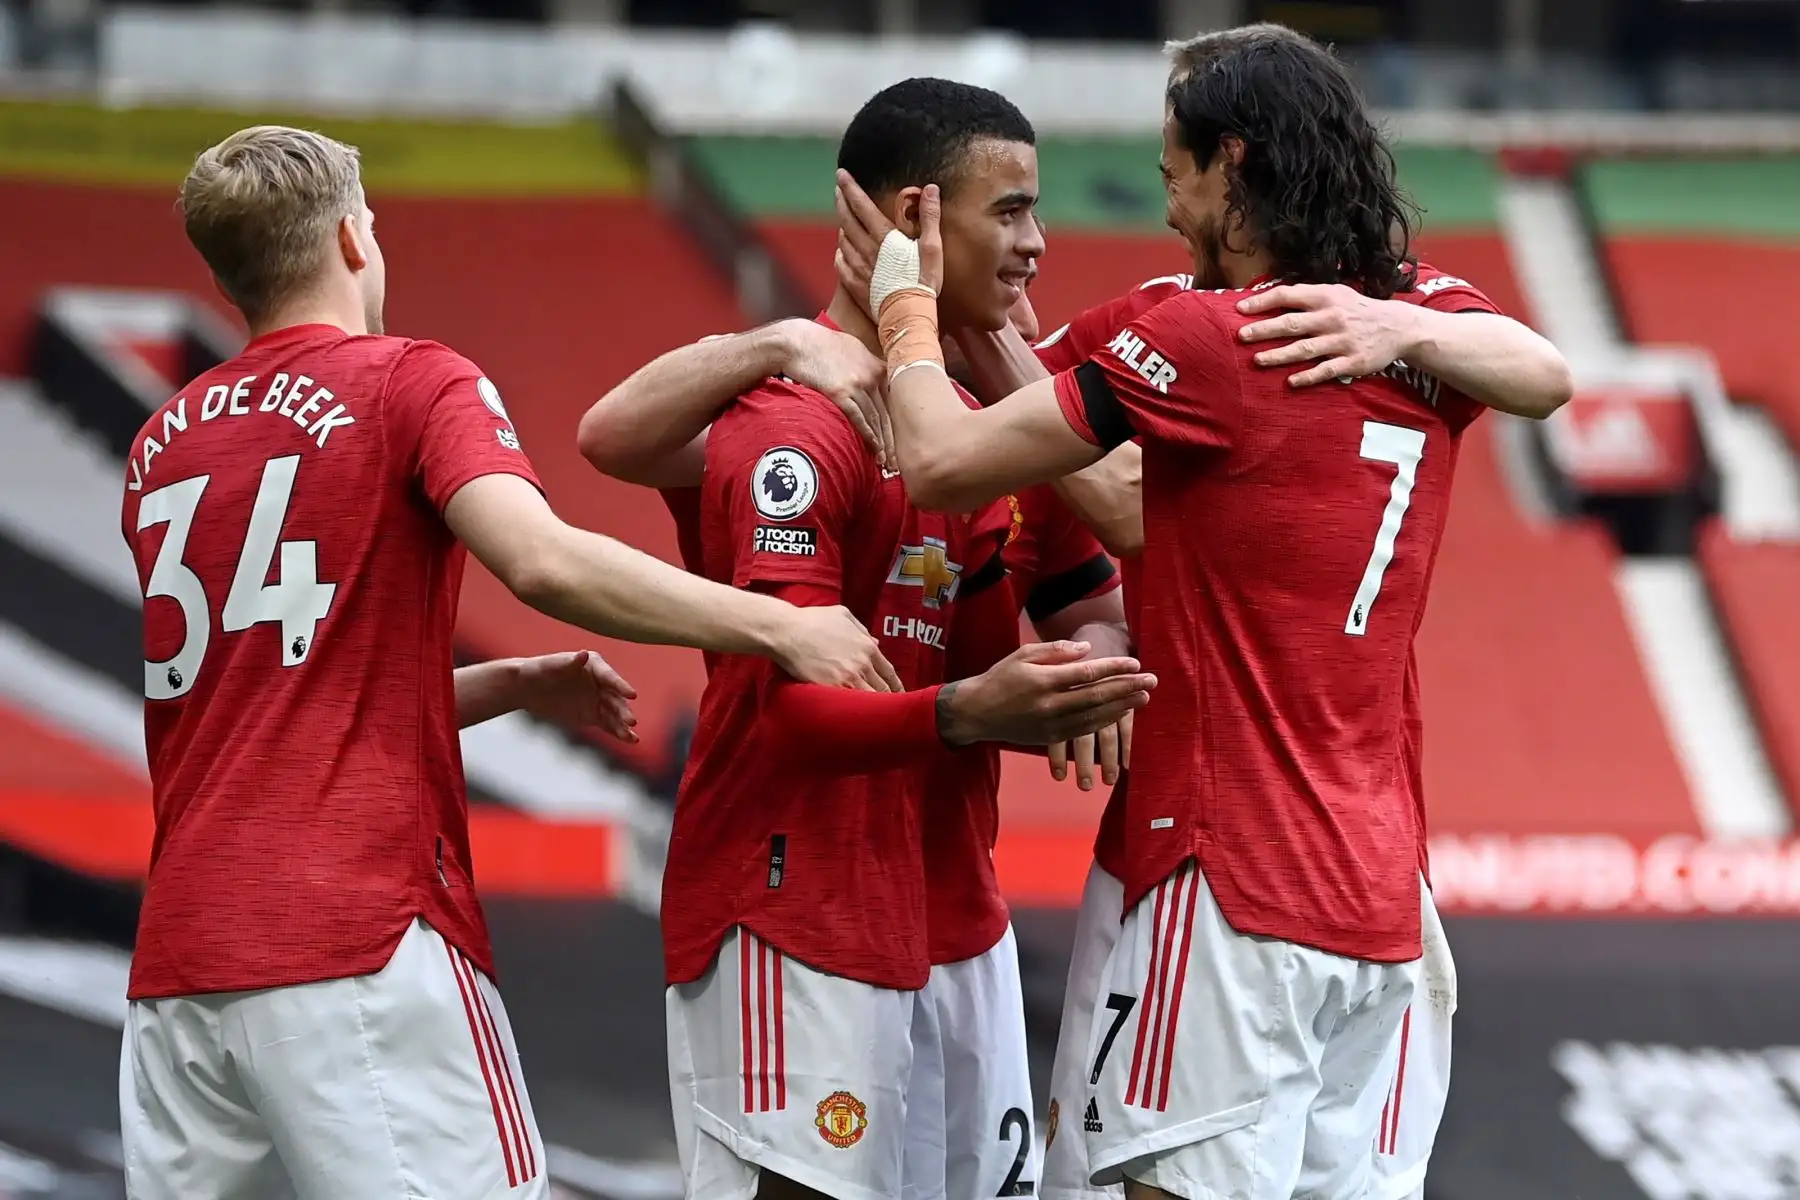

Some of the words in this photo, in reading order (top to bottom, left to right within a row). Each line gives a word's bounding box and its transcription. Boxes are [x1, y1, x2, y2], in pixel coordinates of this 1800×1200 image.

[128, 398, 188, 491] VAN
[200, 375, 257, 422] DE
[258, 372, 356, 448] BEEK
[765, 539, 816, 556] racism
[766, 528, 809, 543] room
[1344, 420, 1427, 636] 7
[136, 454, 337, 700] 34
[1090, 992, 1137, 1085] 7
[827, 1133, 857, 1145] UNITED
[996, 1107, 1035, 1197] 2
